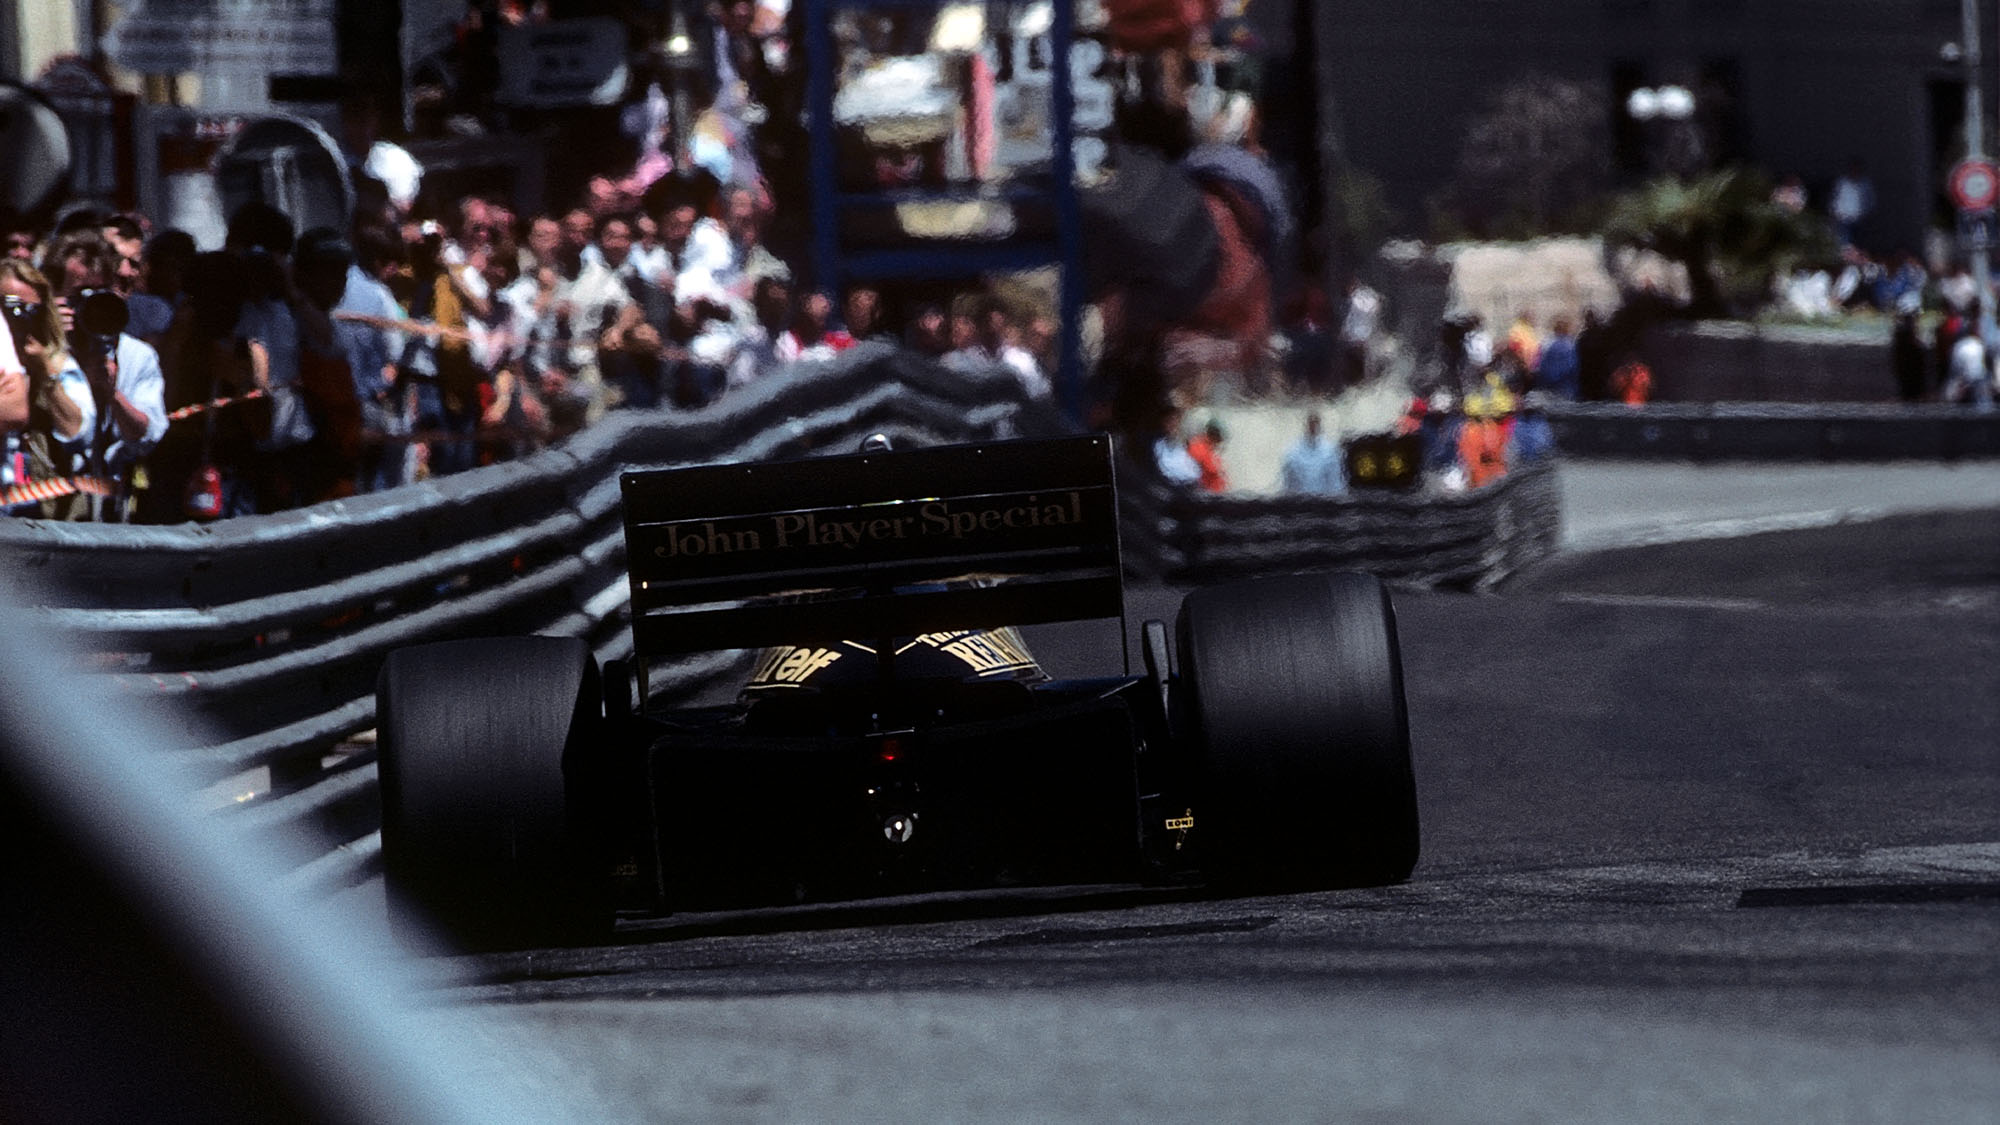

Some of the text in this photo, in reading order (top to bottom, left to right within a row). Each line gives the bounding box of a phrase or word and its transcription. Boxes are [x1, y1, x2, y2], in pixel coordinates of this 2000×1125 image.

[653, 492, 1084, 558] John Player Special
[775, 648, 842, 682] elf
